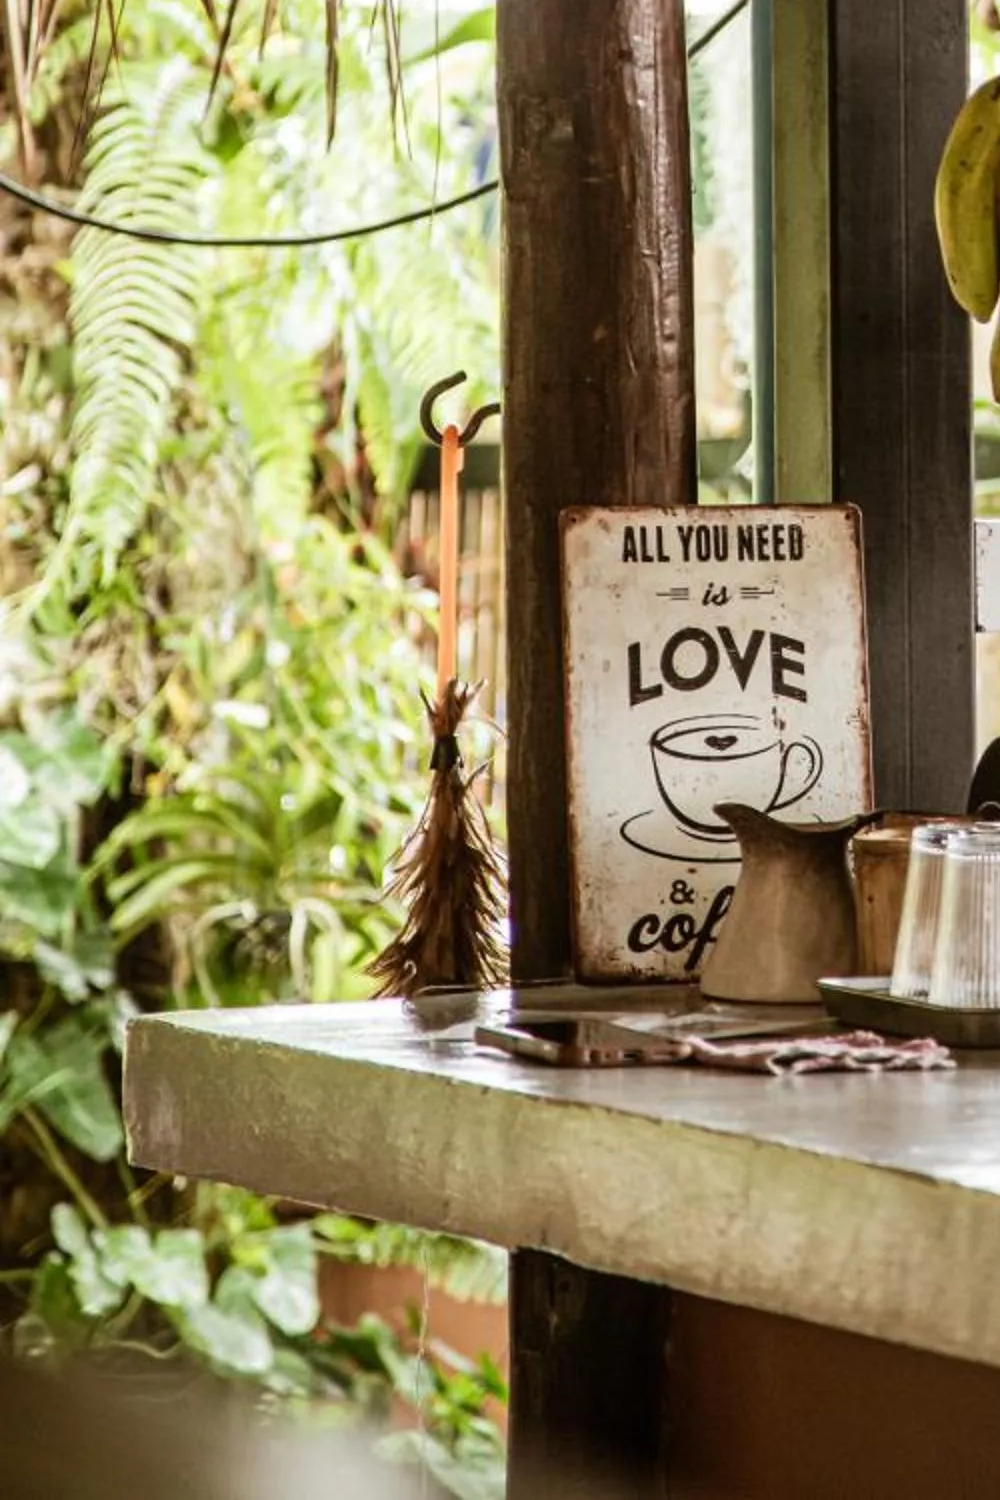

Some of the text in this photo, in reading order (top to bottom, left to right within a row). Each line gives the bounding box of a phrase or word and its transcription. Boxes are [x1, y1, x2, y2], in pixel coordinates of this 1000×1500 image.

[622, 524, 805, 563] ALL YOU NEED
[701, 582, 731, 606] is
[627, 626, 807, 706] LOVE
[669, 879, 695, 905] &
